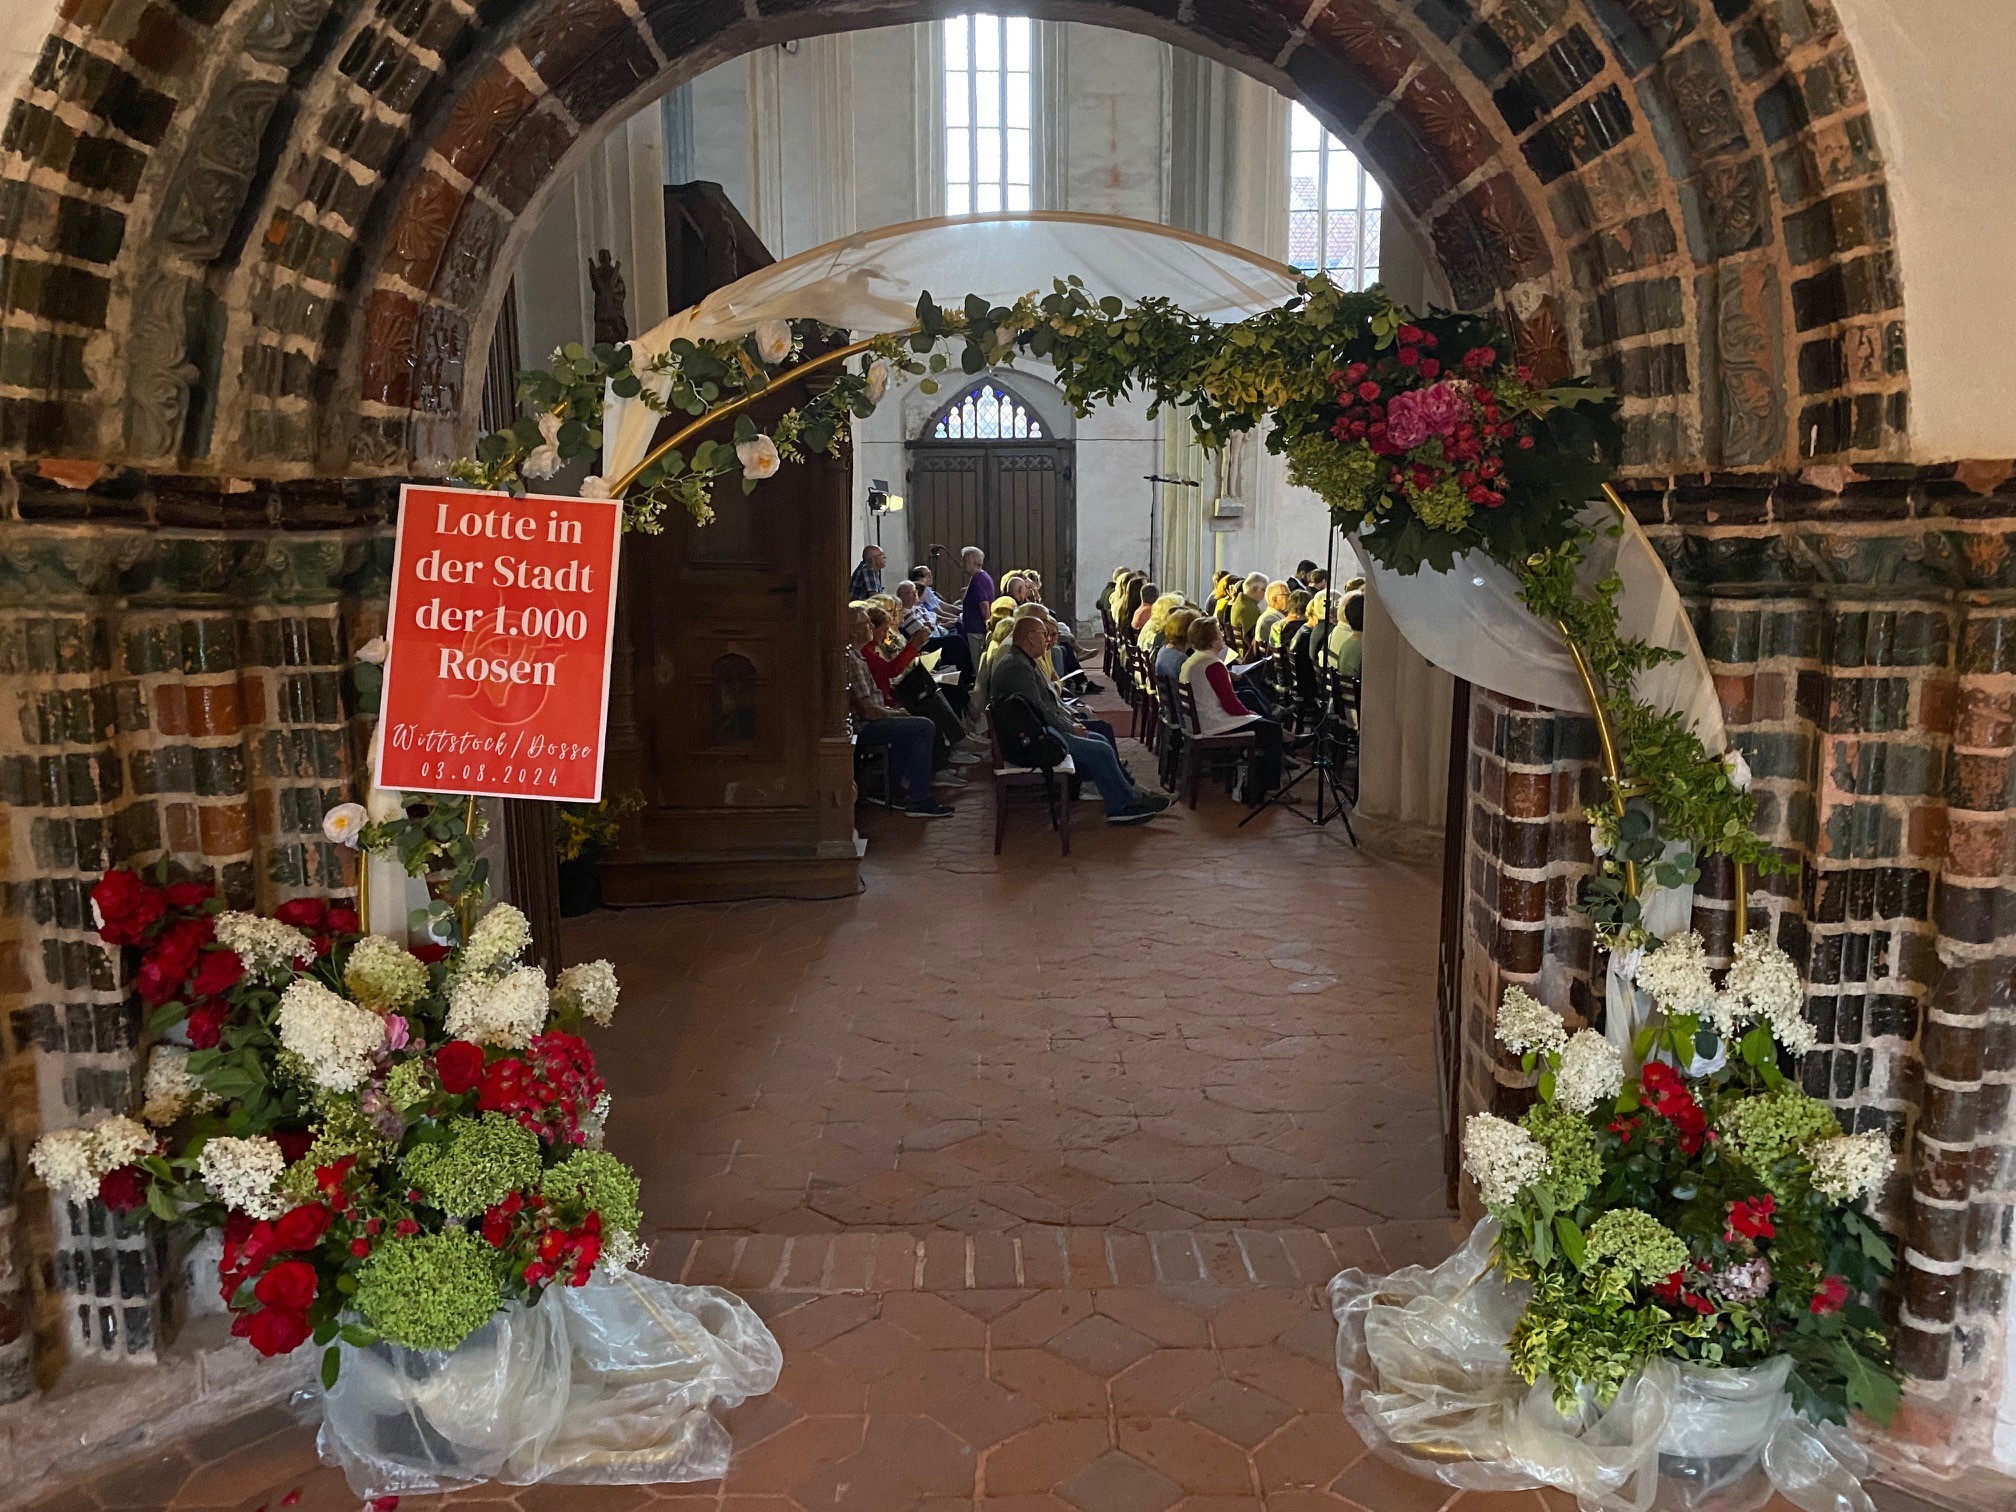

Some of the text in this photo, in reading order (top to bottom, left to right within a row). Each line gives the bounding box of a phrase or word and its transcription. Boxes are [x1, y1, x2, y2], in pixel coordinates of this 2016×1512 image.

[436, 503, 582, 544] Lotte in
[415, 550, 594, 593] der Stadt
[415, 598, 588, 641] der 1.000
[437, 648, 556, 686] Rosen
[392, 723, 592, 761] Wittstock/Dosse
[421, 762, 558, 787] 03.08.2024
